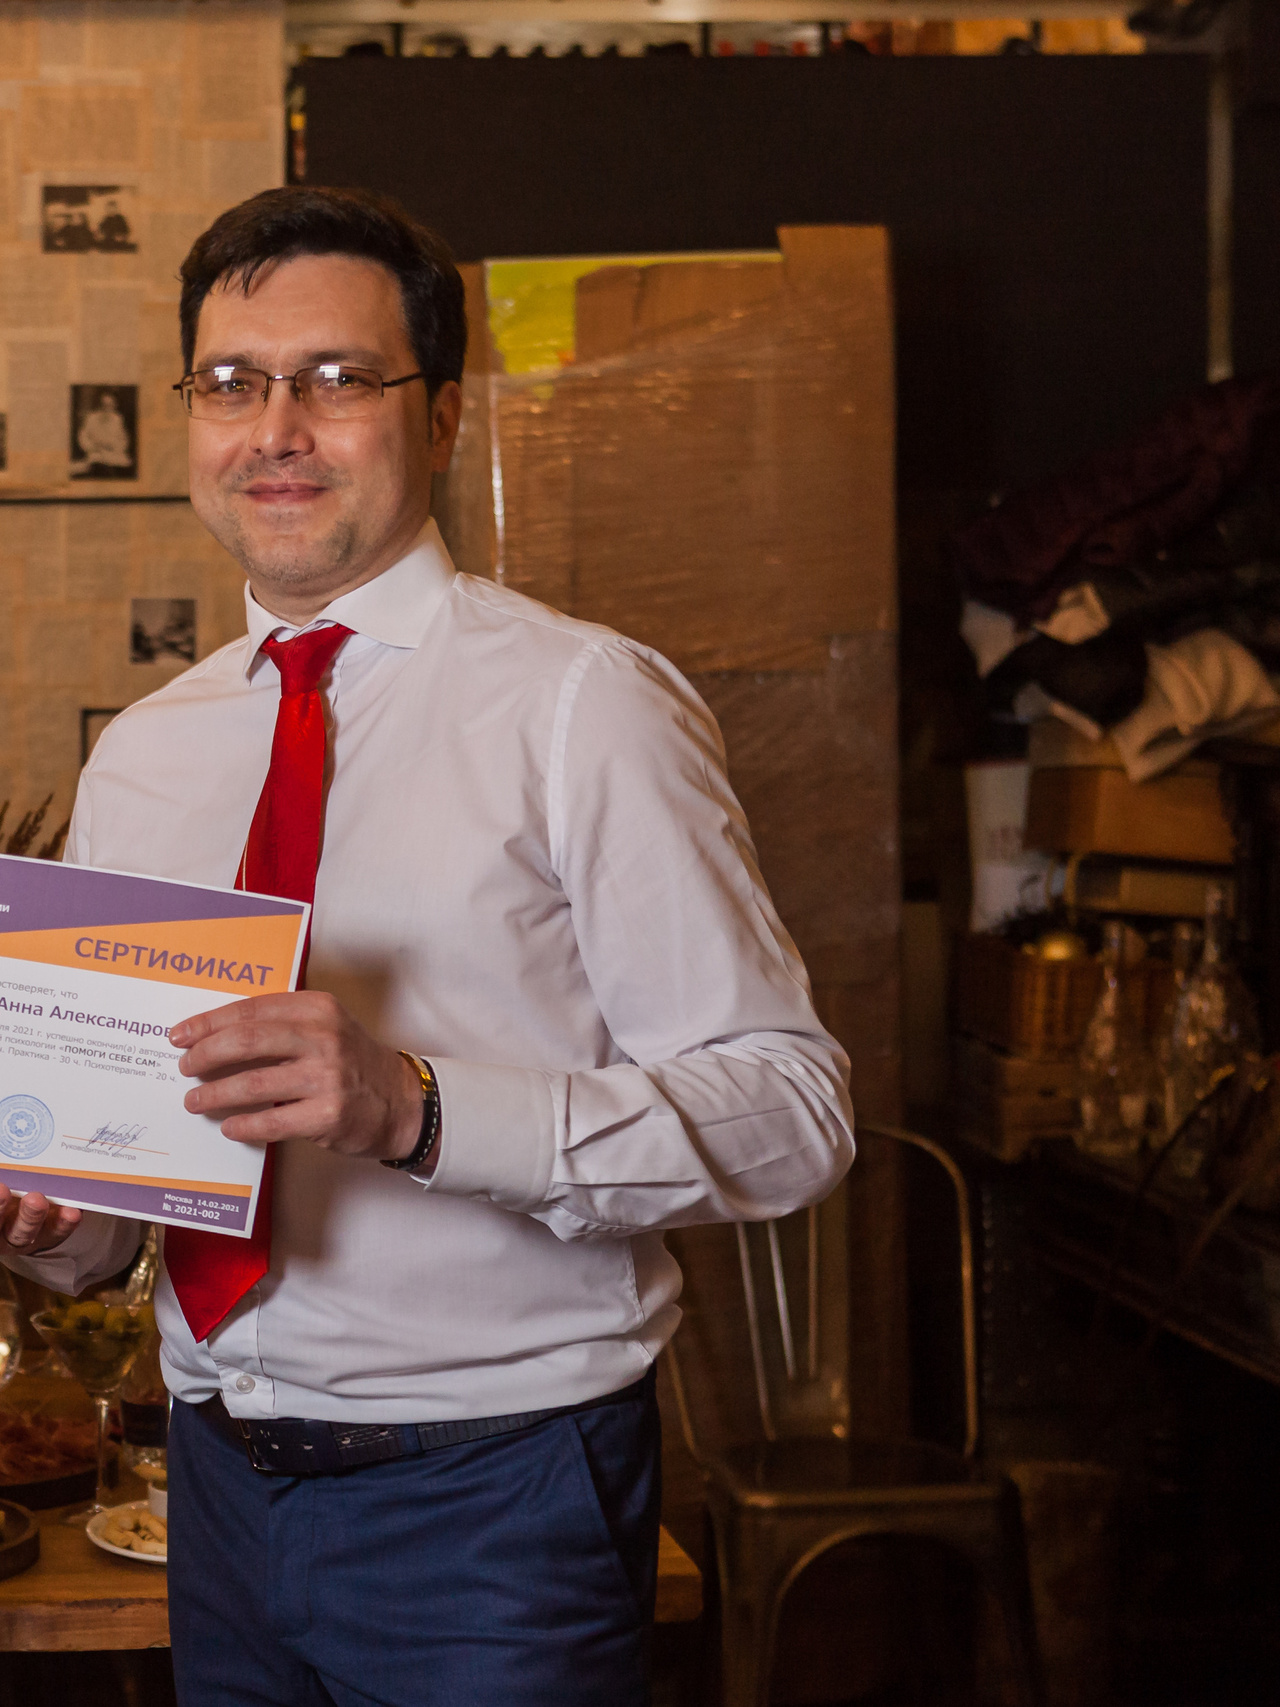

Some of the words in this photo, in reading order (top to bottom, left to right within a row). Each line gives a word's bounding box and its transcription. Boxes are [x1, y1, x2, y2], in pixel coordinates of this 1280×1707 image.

[75, 938, 273, 986] СЕРТИФИКАТ
[61, 991, 78, 1000] что
[50, 1005, 171, 1038] Александров
[5, 1037, 56, 1050] психологии
[109, 1053, 132, 1063] СЕБЕ
[12, 1026, 33, 1035] 2021
[46, 1033, 84, 1044] успешно
[87, 1040, 136, 1054] окончил(а)
[8, 1047, 49, 1060] Практика
[60, 1055, 70, 1064] 30
[84, 1060, 146, 1076] Психотерапия
[156, 1072, 167, 1080] 20
[165, 1194, 192, 1204] Москва
[198, 1200, 238, 1212] 14.02.2021
[174, 1205, 220, 1220] 2021-002
